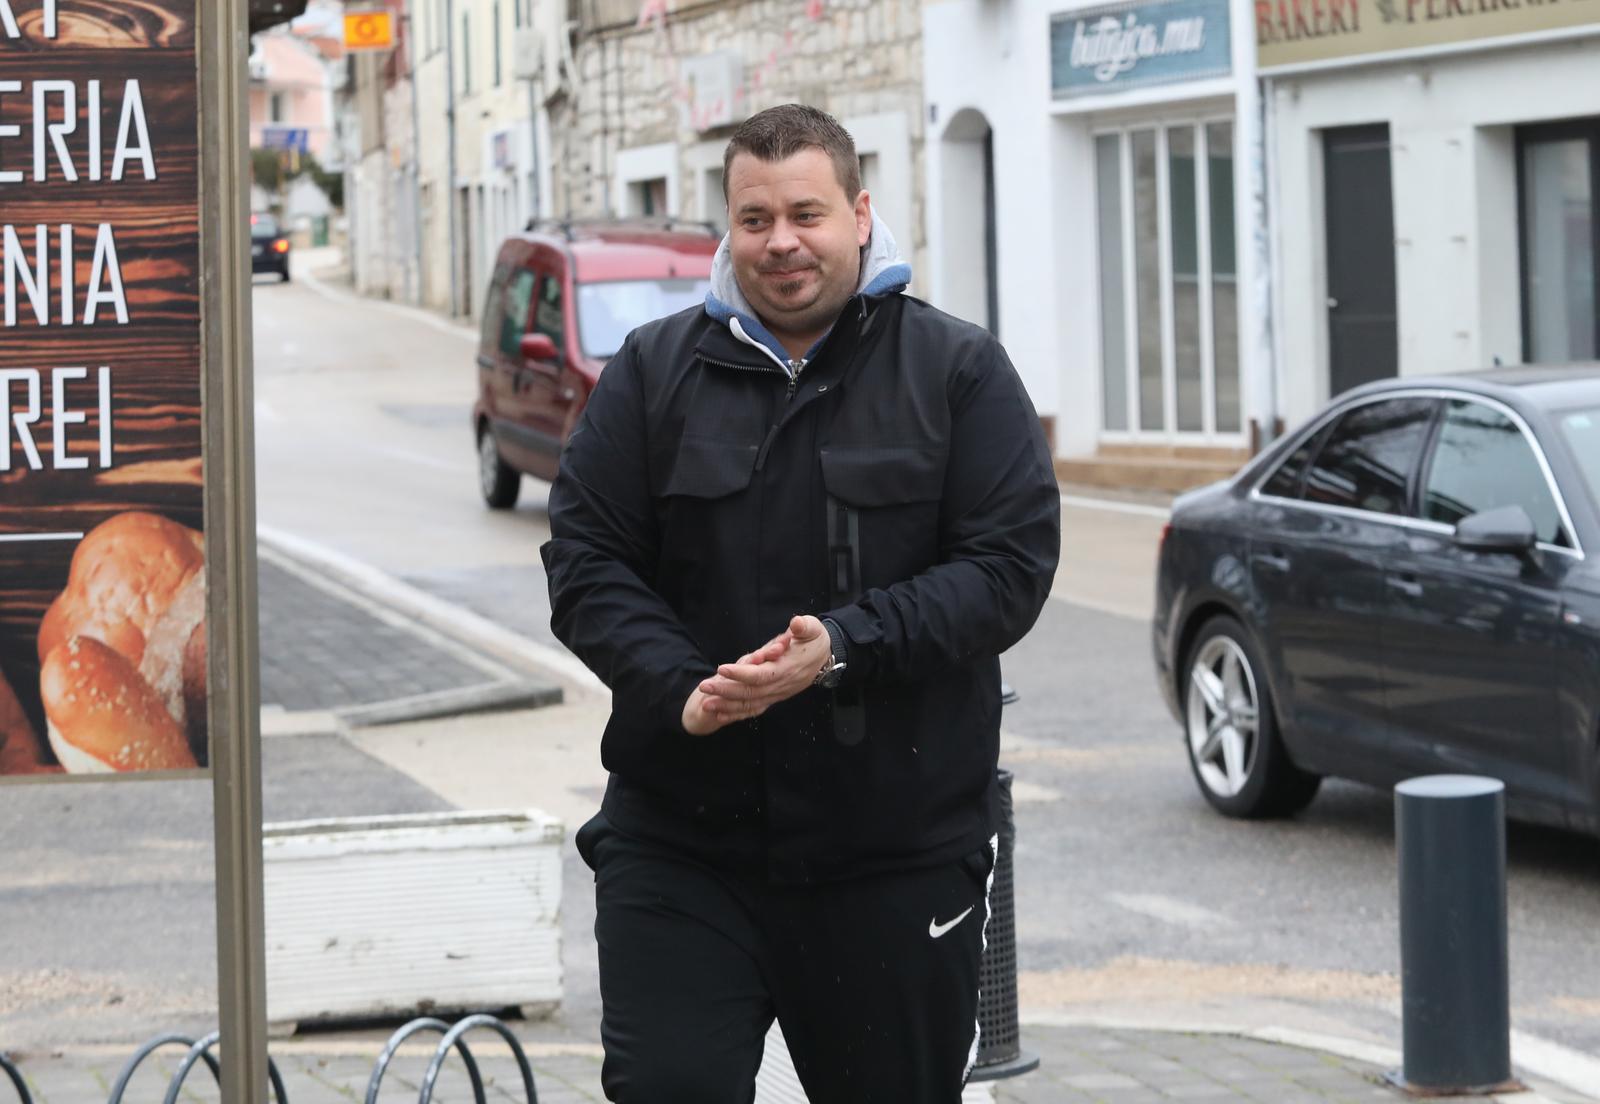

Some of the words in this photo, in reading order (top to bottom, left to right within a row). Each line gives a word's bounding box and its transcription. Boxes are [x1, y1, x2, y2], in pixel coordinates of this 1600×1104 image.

[0, 79, 157, 183] ERIA
[3, 223, 129, 327] NIA
[0, 366, 112, 471] REI
